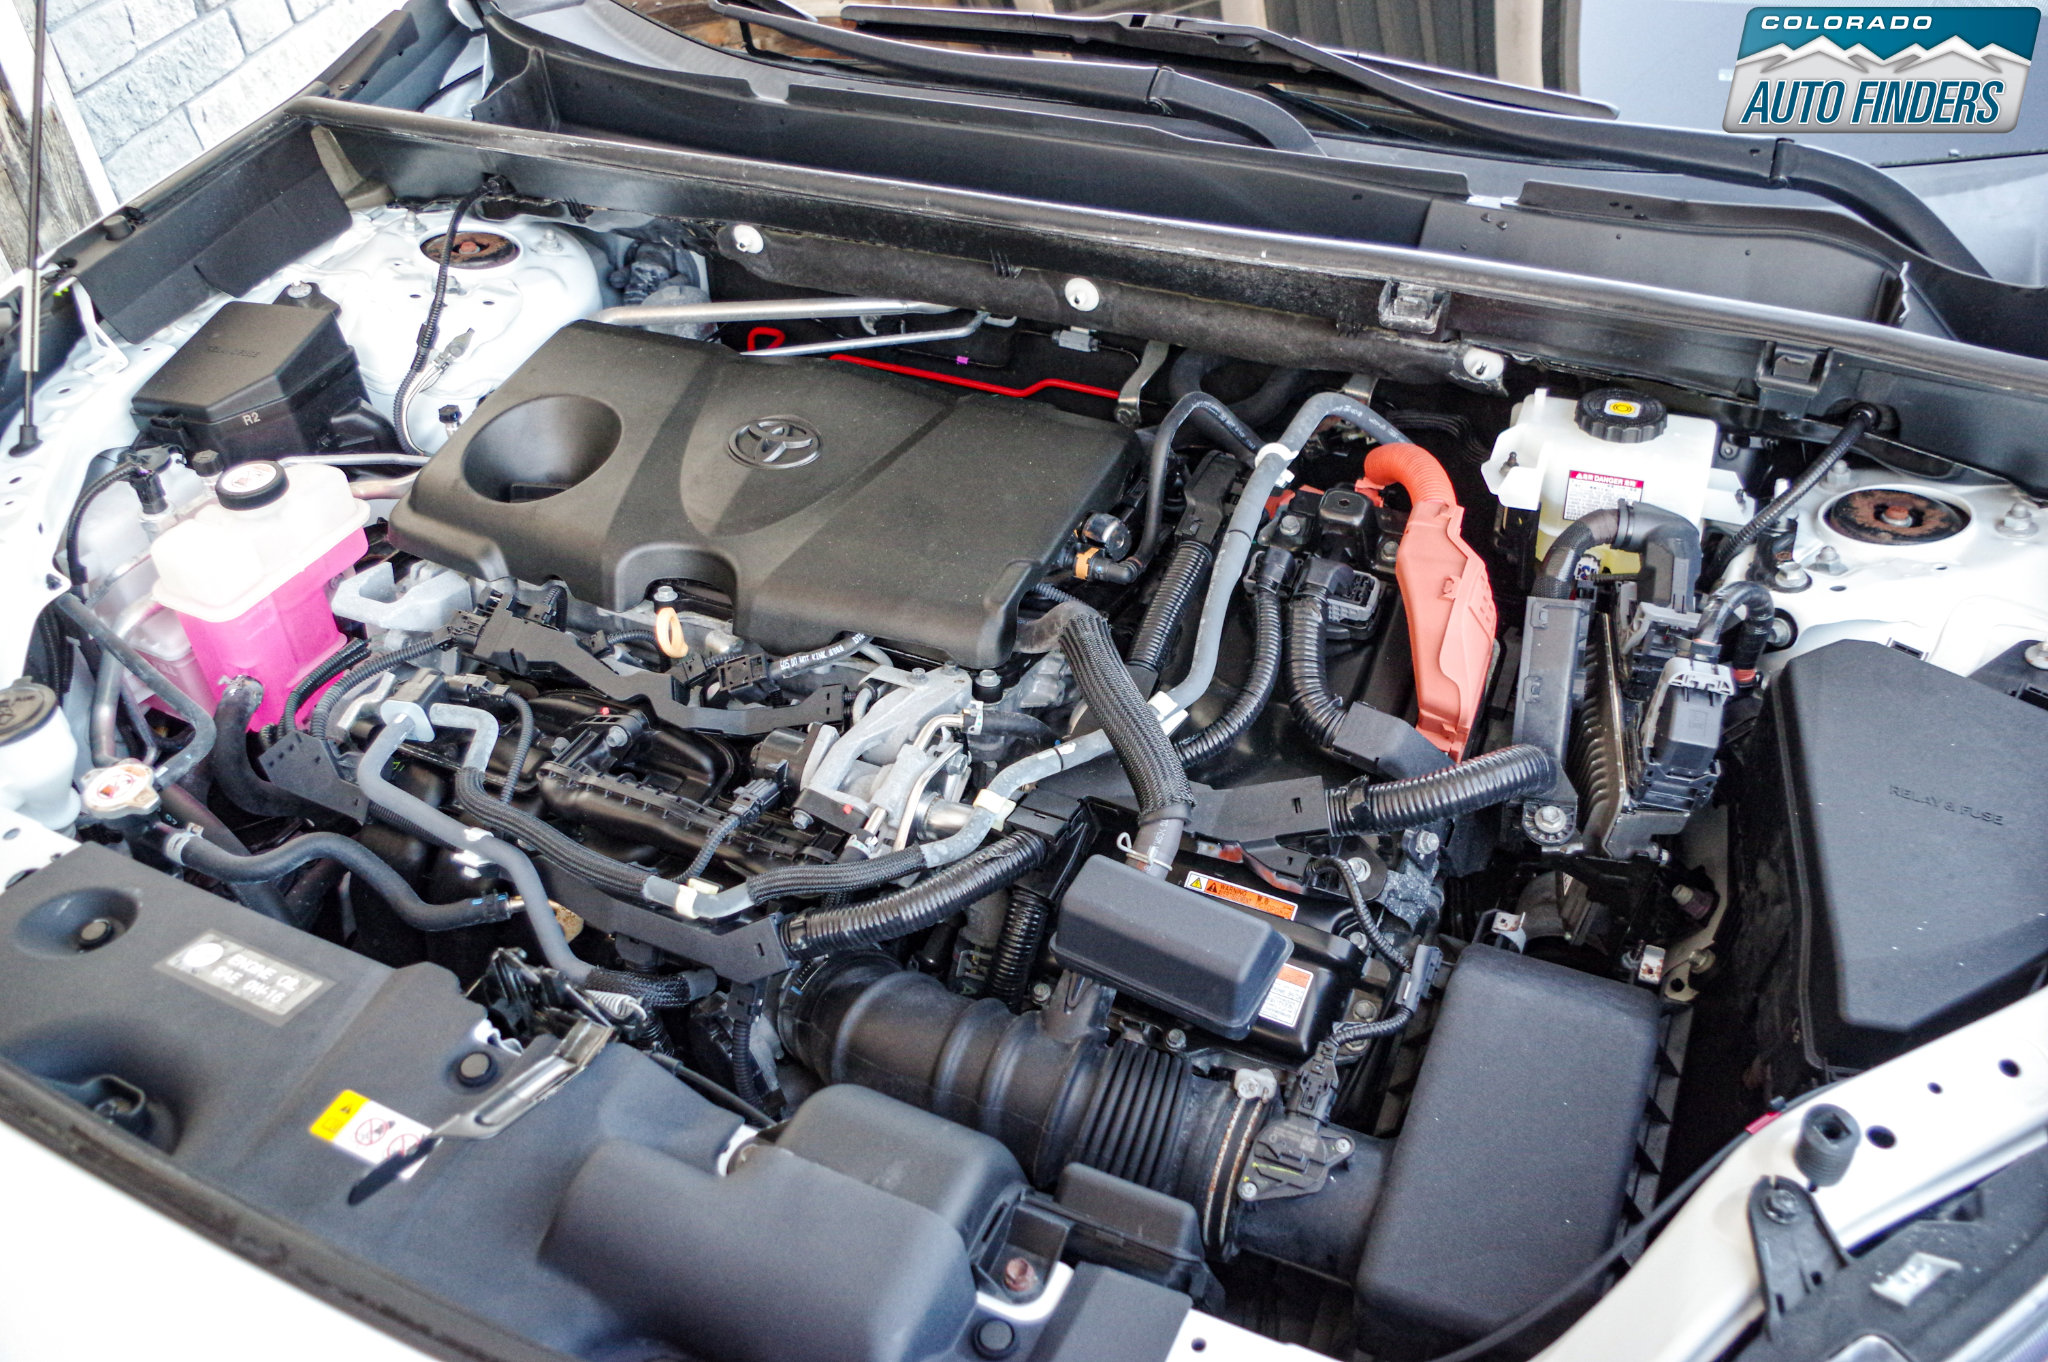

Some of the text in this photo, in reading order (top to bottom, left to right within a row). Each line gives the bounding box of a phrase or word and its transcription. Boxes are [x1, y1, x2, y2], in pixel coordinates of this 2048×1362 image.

[242, 412, 261, 426] R2
[1594, 475, 1624, 486] DANGER
[812, 651, 827, 661] KINK
[1889, 784, 1939, 808] RELAY
[1960, 805, 2003, 826] FUSE
[211, 965, 244, 985] SAE
[227, 953, 278, 980] ENGINE
